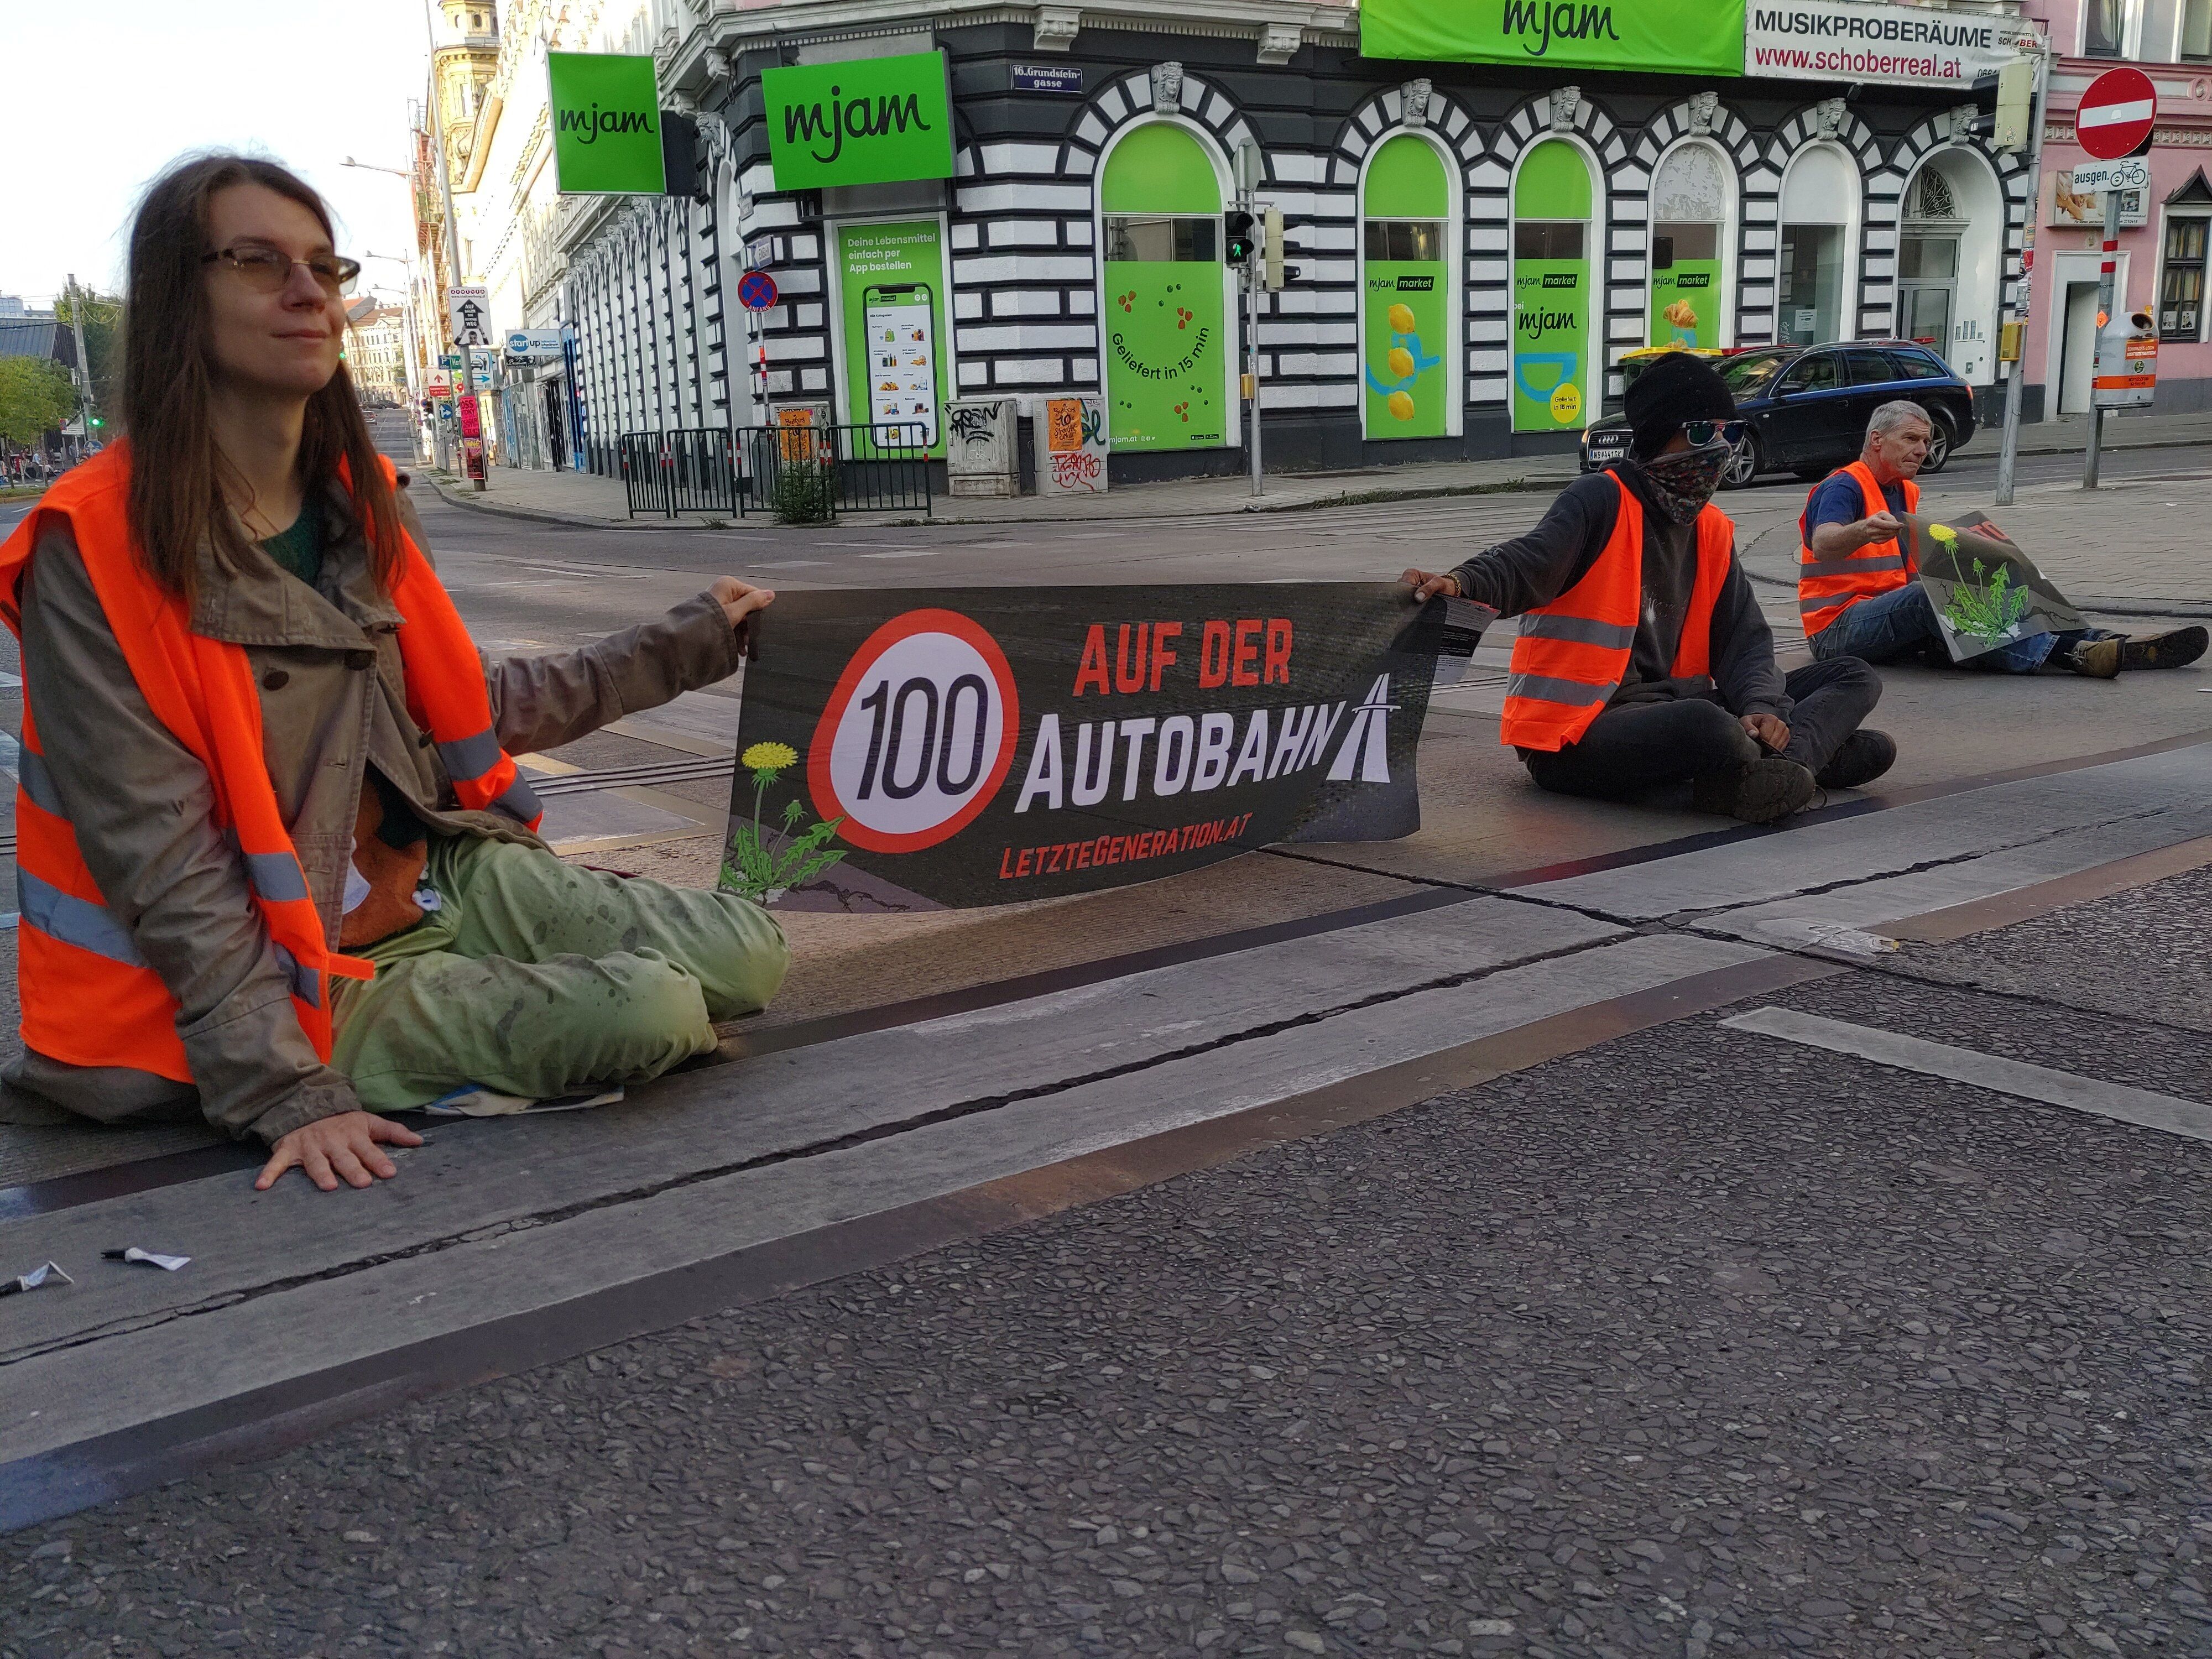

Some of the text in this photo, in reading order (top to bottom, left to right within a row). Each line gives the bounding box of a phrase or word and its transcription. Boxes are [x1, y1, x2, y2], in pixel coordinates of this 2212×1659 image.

[1503, 0, 1620, 55] mjam
[1755, 9, 1992, 49] MUSIKPROBERÄUME
[1998, 36, 2037, 48] SCHBER
[1755, 46, 1961, 79] www.schoberreal.at
[1034, 80, 1062, 88] gasse
[560, 103, 655, 144] mjam
[785, 86, 931, 163] mjam
[2074, 171, 2110, 185] ausgen.
[848, 233, 936, 247] Deine Lebensmittel
[849, 249, 900, 260] einfach per
[849, 261, 912, 274] App bestellen
[1517, 274, 1575, 289] mjam market
[1653, 275, 1708, 289] mjam market
[1369, 278, 1432, 291] mjam market
[1519, 306, 1577, 340] mjam
[1113, 327, 1209, 380] Geliefert in 15 min
[1109, 436, 1137, 444] mjam.at
[1072, 618, 1293, 697] AUF DER
[857, 674, 989, 800] 100
[1014, 701, 1347, 813] AUTOBAHN
[999, 812, 1253, 879] LETZTEGENERATION.AT
